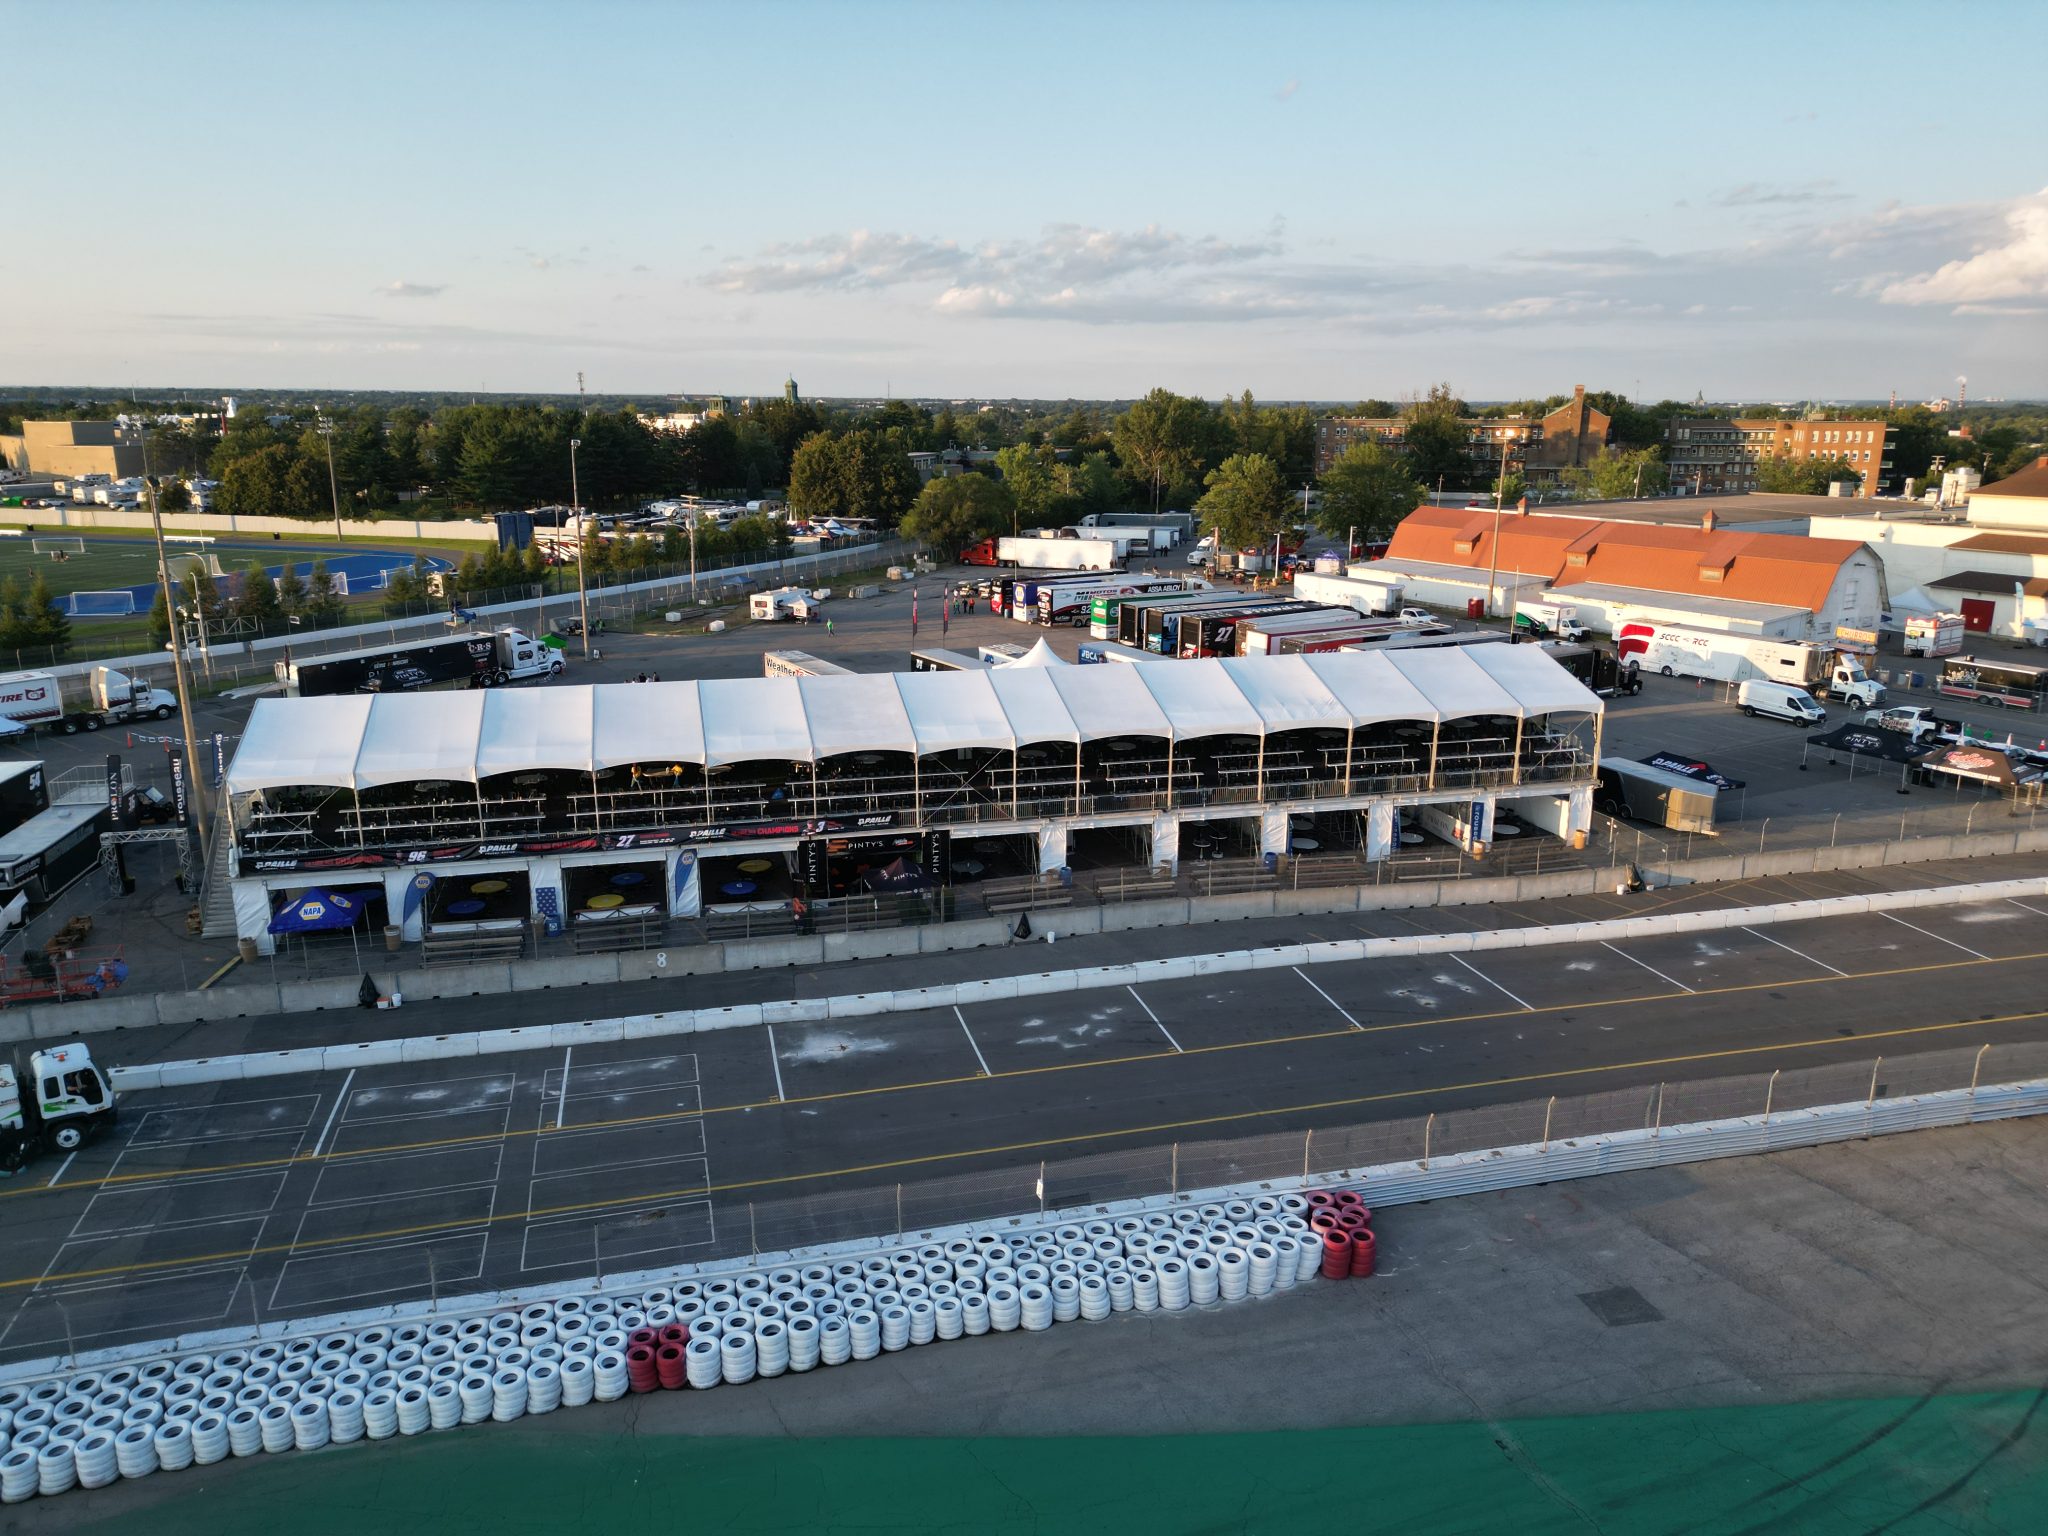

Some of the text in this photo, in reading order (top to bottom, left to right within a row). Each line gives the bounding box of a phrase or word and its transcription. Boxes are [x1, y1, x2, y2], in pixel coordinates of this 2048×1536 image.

[1148, 583, 1182, 593] ASSA ABLOY
[1214, 627, 1234, 643] 27
[1659, 633, 1710, 647] SCCC RCC
[0, 693, 23, 703] IRE
[1844, 735, 1880, 748] PINTY'S
[172, 758, 183, 815] rousseau
[757, 825, 799, 836] CHAMPIONS
[815, 821, 826, 833] 3
[616, 834, 637, 848] 27
[848, 840, 884, 849] PINTY'S
[407, 851, 428, 862] 96
[932, 832, 940, 873] PINTY'S
[809, 842, 817, 883] PINTY'S
[303, 906, 321, 916] NAPA
[656, 952, 667, 968] 8
